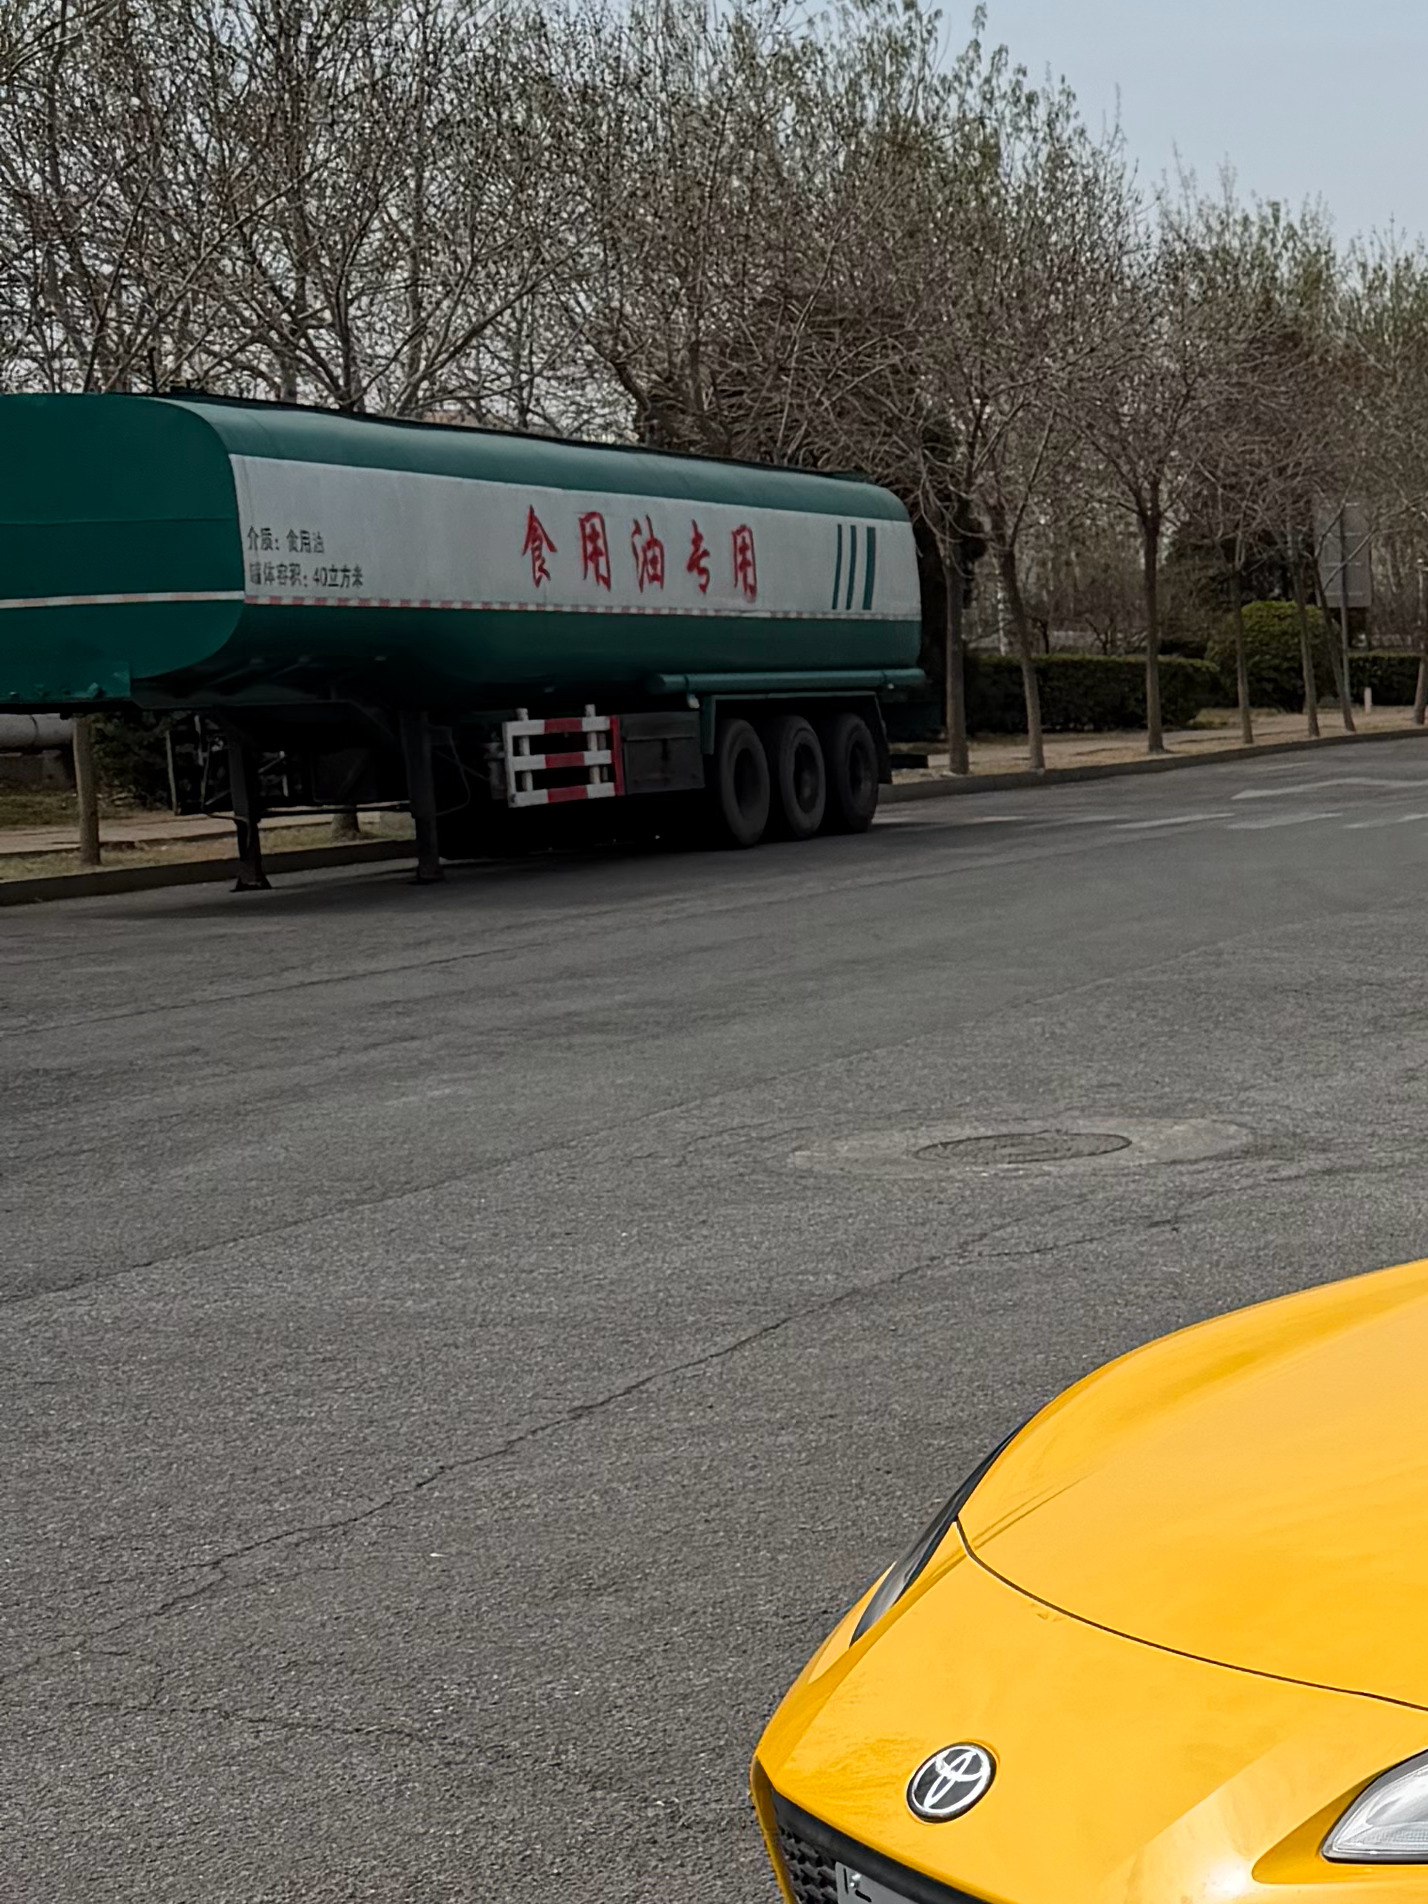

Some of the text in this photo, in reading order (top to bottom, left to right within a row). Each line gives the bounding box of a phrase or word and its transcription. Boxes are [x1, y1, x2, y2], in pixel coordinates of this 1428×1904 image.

[522, 504, 757, 603] 食用油专用
